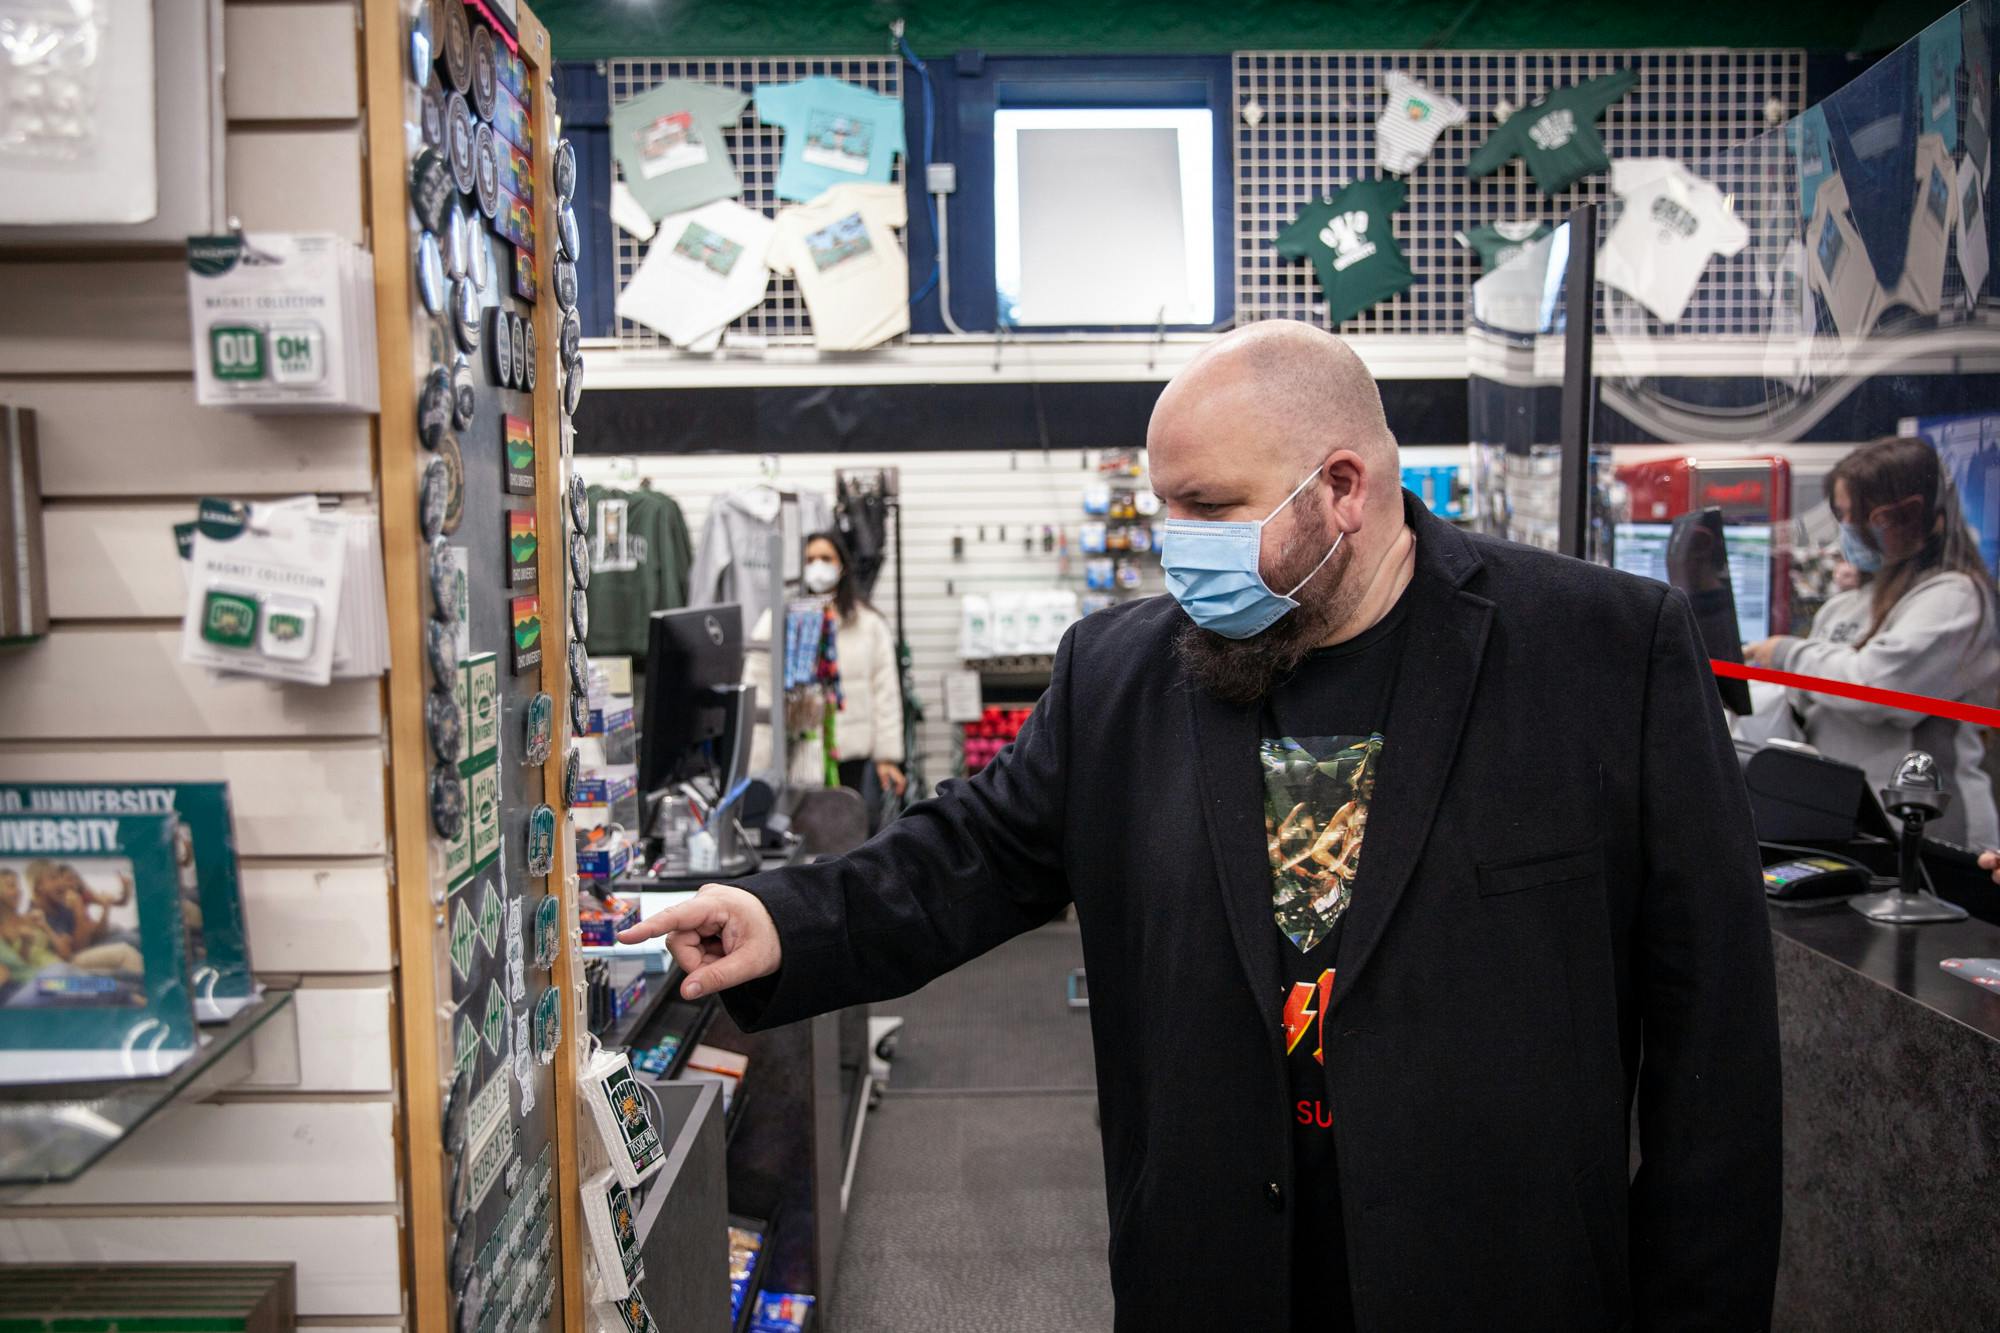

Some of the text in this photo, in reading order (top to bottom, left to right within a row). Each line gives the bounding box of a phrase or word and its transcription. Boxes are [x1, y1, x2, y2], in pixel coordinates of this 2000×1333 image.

[206, 296, 325, 309] MAGNET COLLECTION
[217, 333, 258, 366] OU
[206, 560, 327, 588] MAGNET COLLECTION
[474, 672, 495, 705] OHIO
[31, 788, 177, 813] UNIVERSITY
[475, 778, 496, 812] OHIO
[0, 819, 120, 851] IVERSITY
[470, 1067, 507, 1137] BOBCATS
[611, 1081, 643, 1123] OHIO
[473, 1119, 510, 1194] BOBCATS
